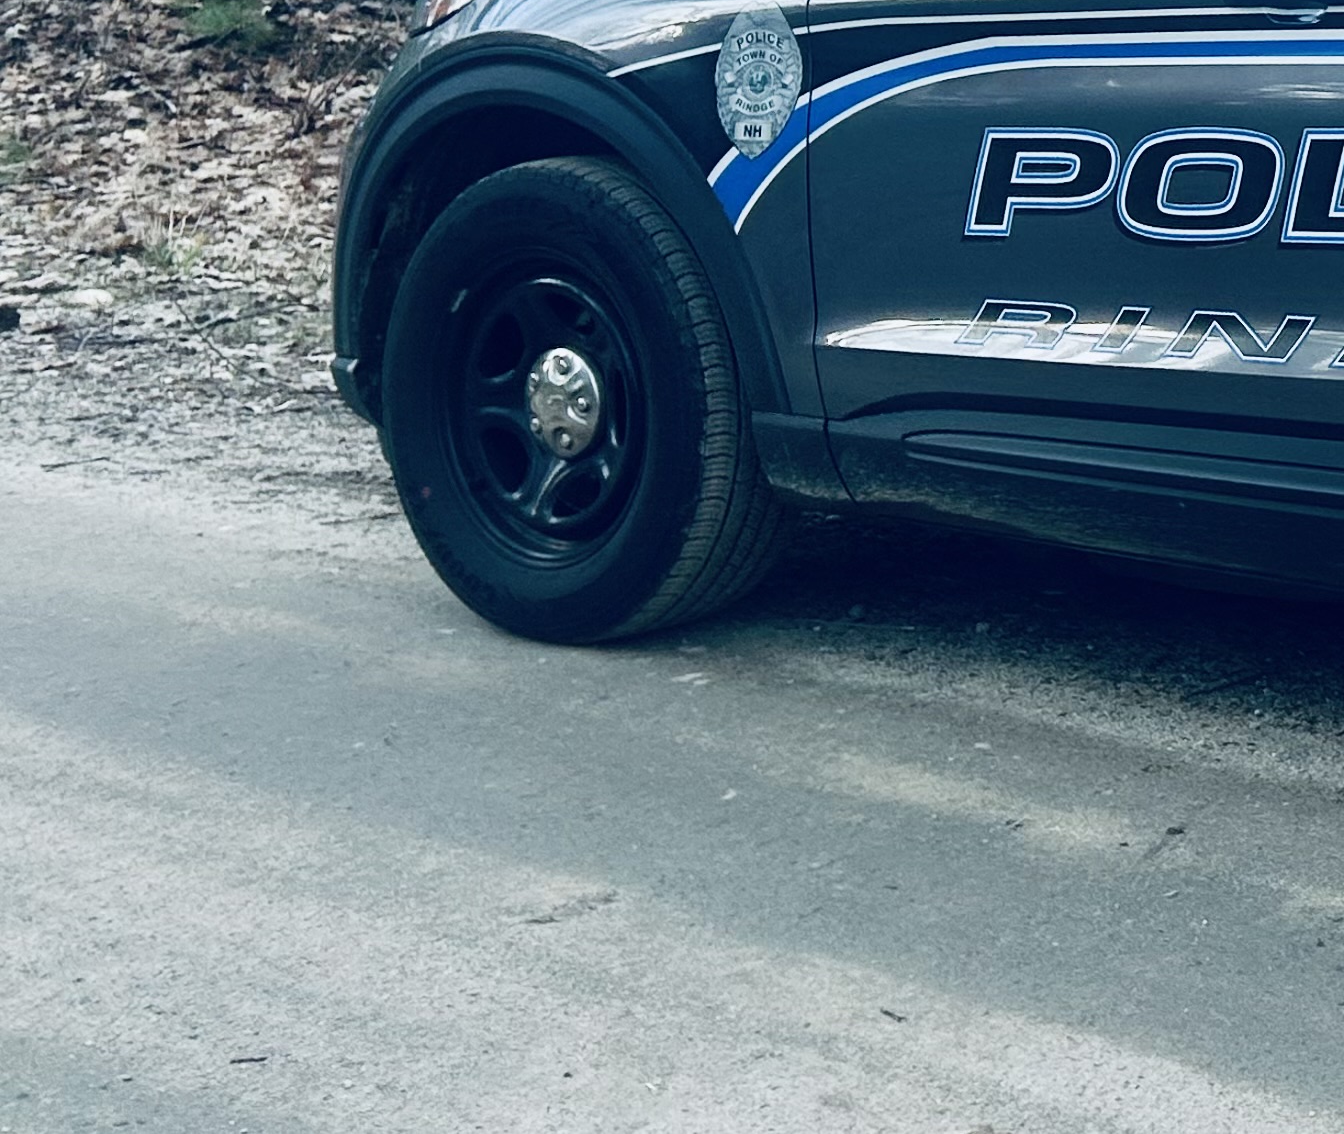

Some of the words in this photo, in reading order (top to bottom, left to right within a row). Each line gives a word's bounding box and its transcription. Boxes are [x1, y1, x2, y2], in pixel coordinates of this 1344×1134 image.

[737, 31, 784, 50] POLICE
[737, 50, 766, 65] TOWN
[770, 53, 783, 64] OF
[736, 98, 775, 112] RINDGE
[743, 125, 762, 137] NH
